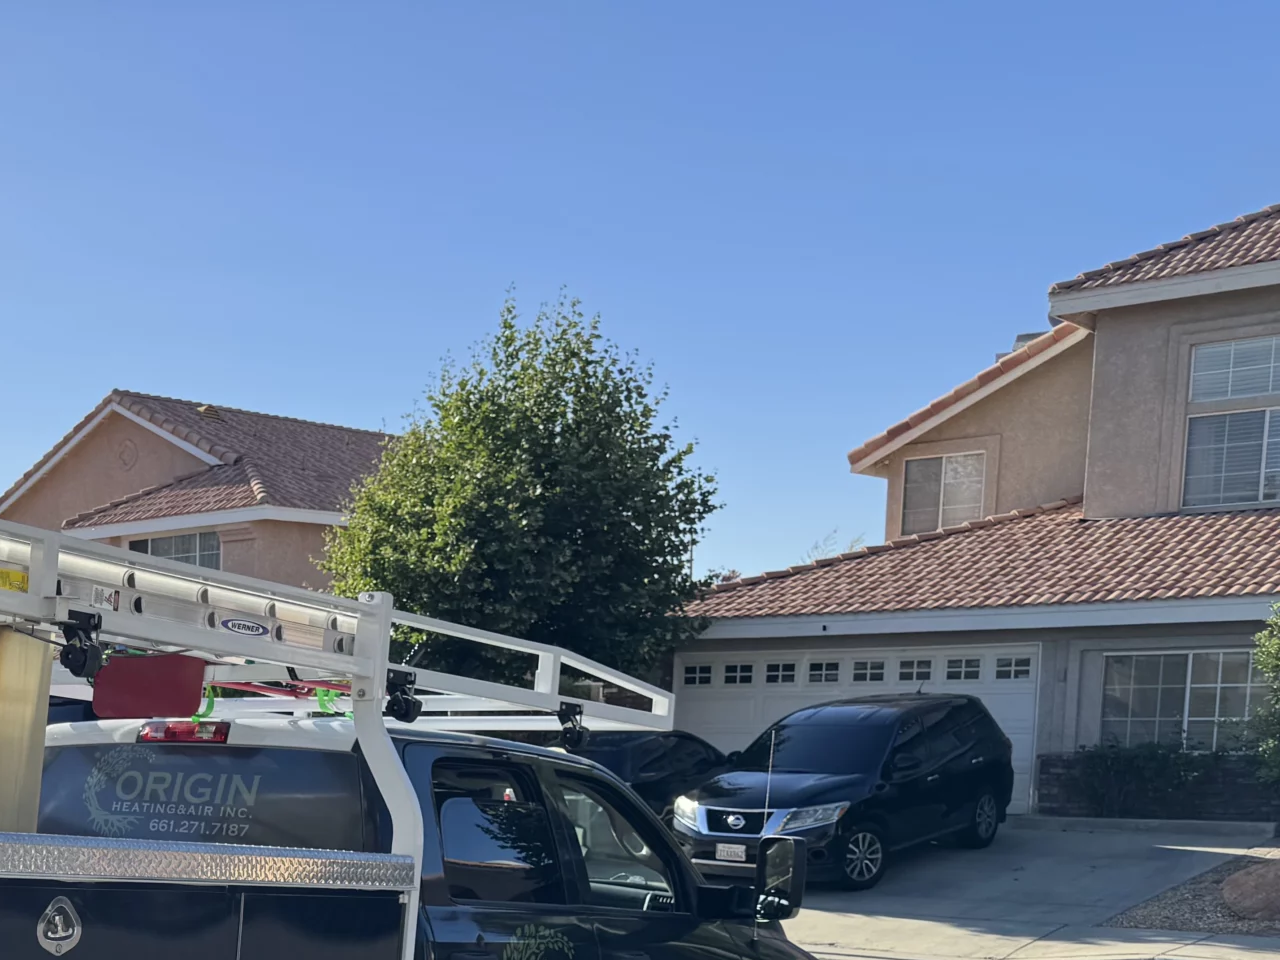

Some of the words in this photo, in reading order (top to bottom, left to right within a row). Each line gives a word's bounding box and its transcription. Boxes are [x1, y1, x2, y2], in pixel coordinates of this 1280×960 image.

[231, 621, 261, 633] WERNER
[115, 770, 262, 806] ORIGIN
[111, 801, 214, 817] HEATING&AIR
[220, 807, 253, 819] INC.
[149, 818, 249, 837] 661.271.7187
